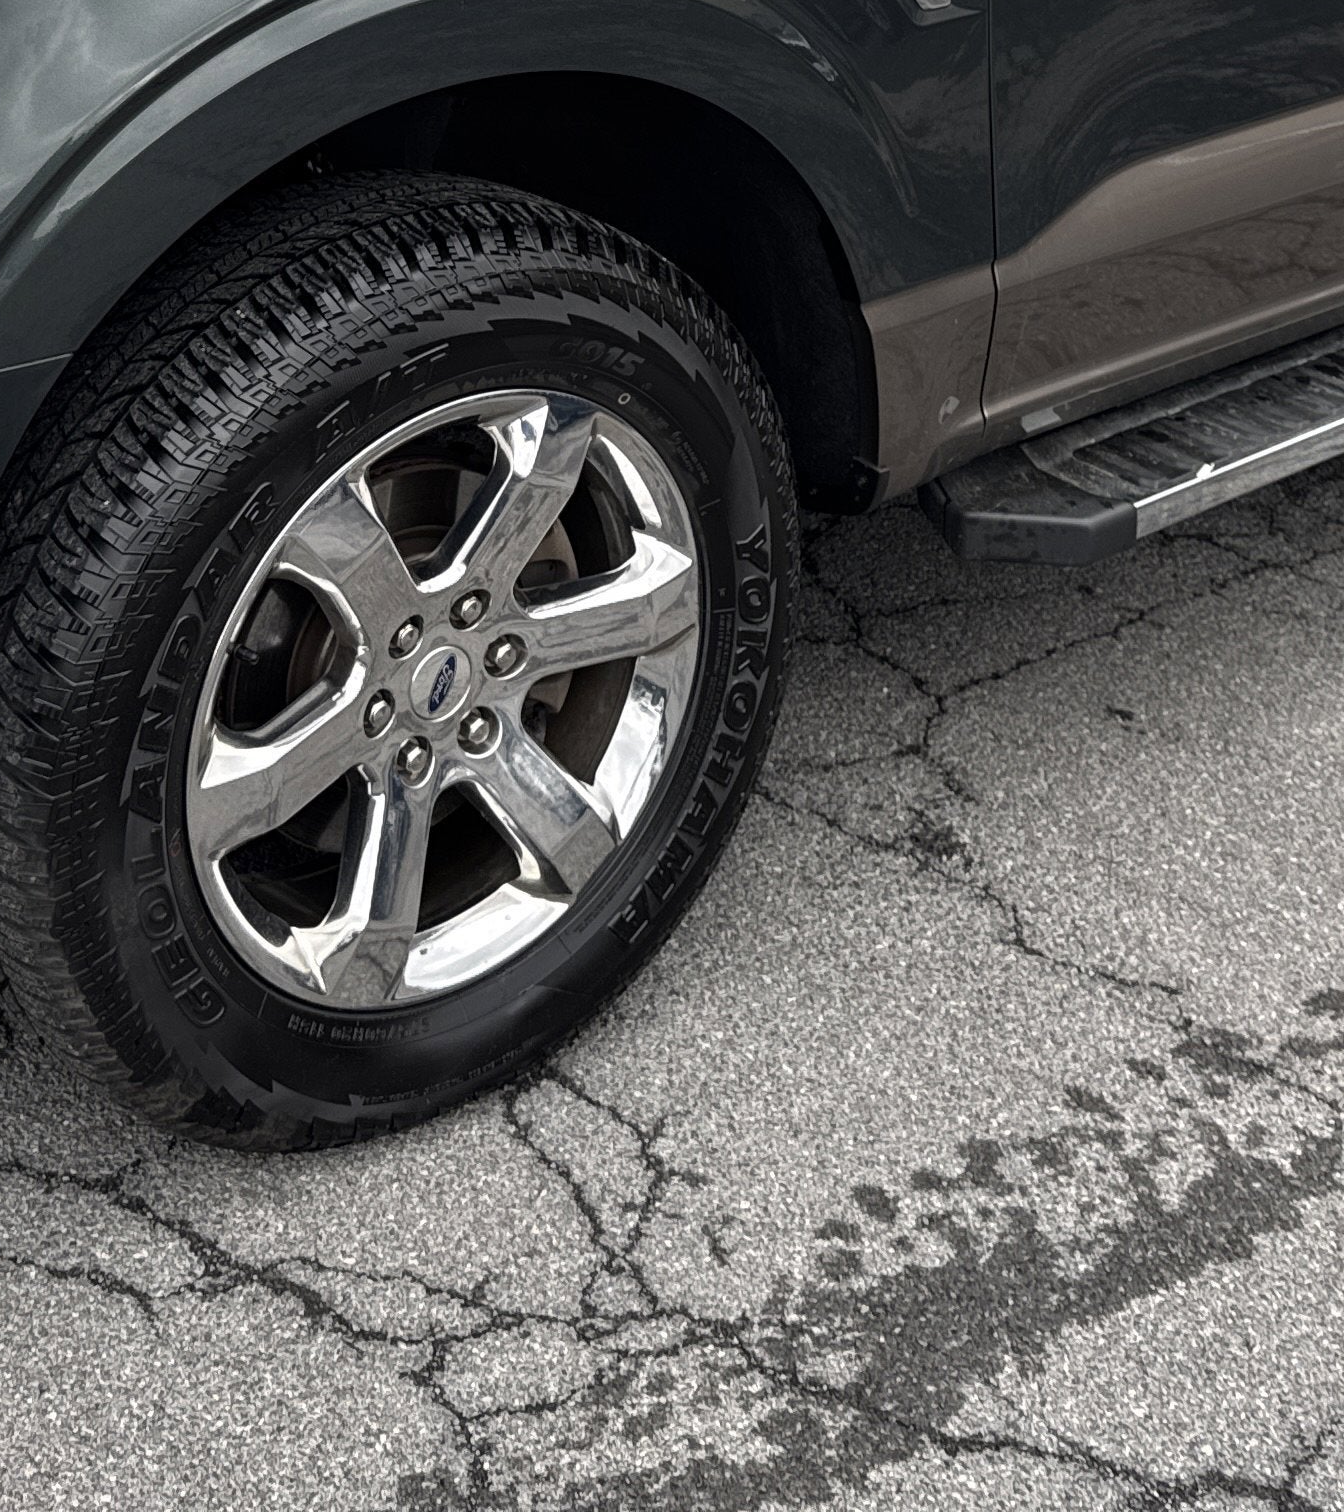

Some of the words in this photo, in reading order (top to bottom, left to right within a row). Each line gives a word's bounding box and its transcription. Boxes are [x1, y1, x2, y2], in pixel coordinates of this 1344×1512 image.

[130, 482, 277, 1029] GEOLANDAR
[431, 664, 454, 705] Ford
[610, 525, 773, 945] YOKOHAMA
